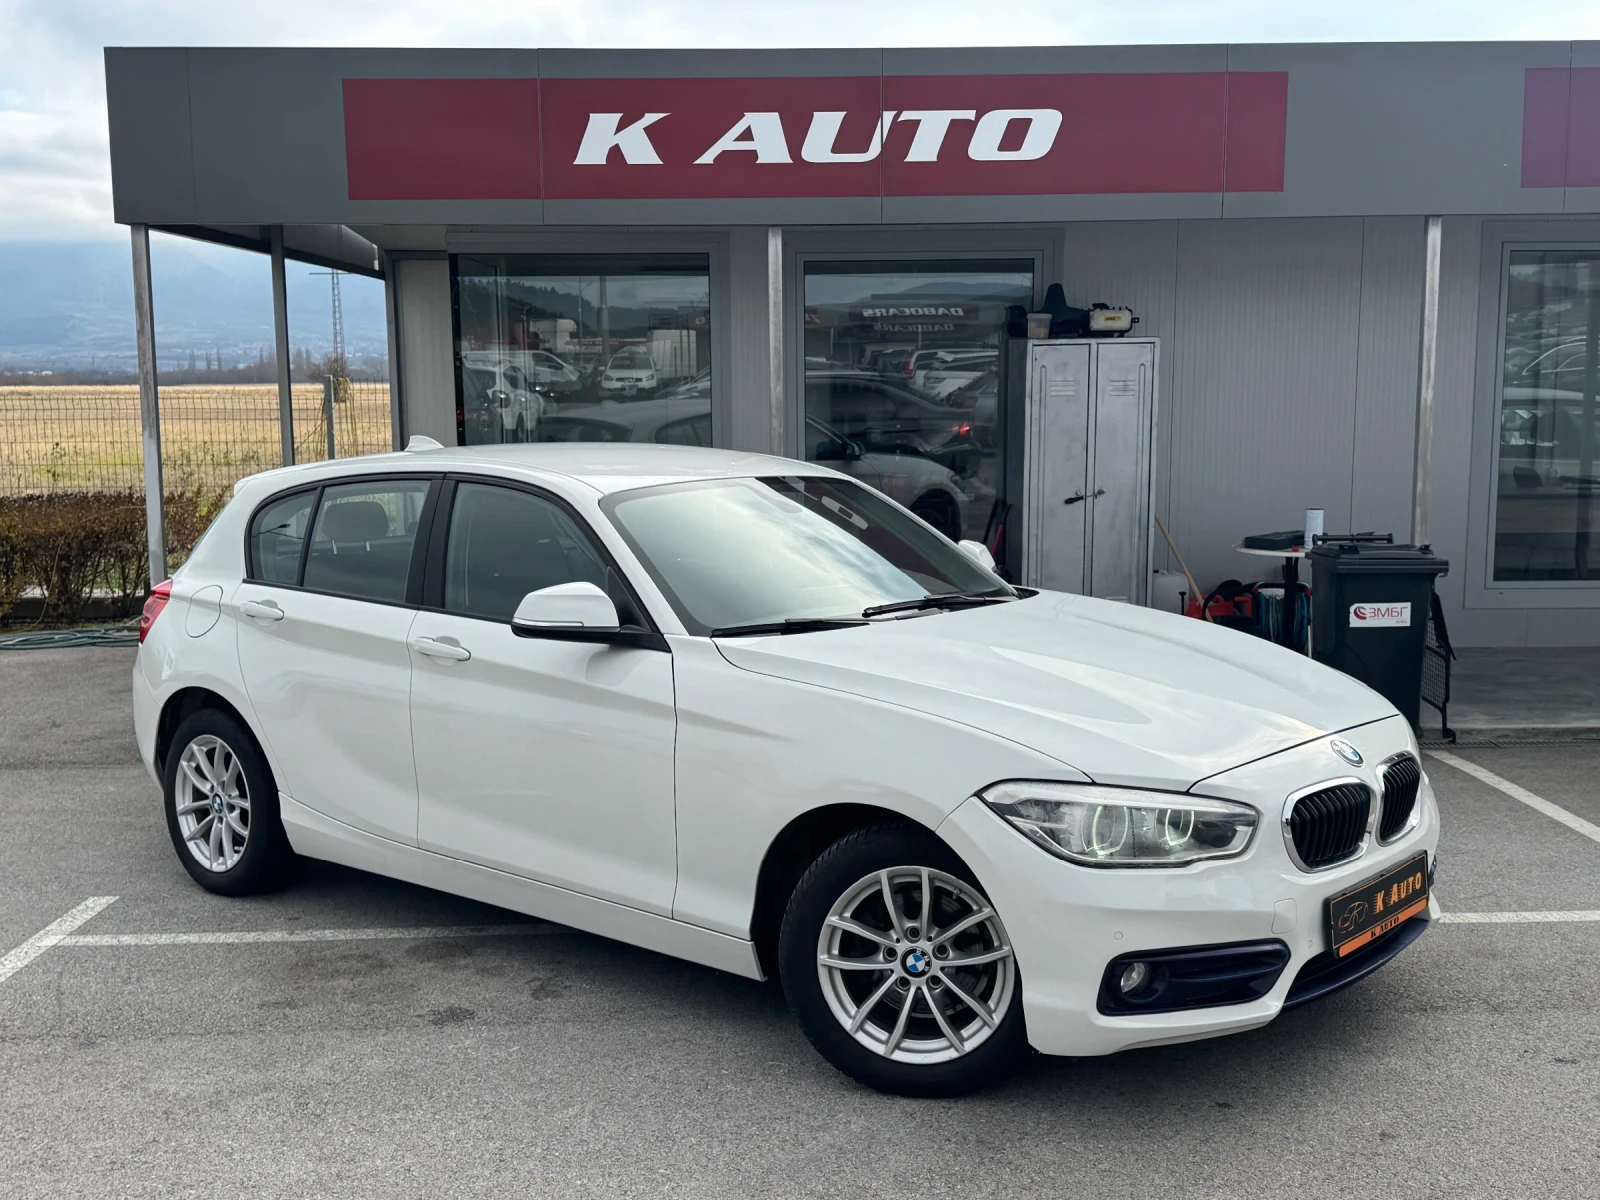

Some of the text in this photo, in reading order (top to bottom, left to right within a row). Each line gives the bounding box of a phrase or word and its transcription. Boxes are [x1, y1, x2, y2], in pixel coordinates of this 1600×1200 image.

[573, 108, 1063, 165] K AUTO
[1368, 606, 1408, 618] ЗМБГ
[1373, 872, 1422, 915] K AUTO
[1370, 916, 1400, 939] K AUTO
